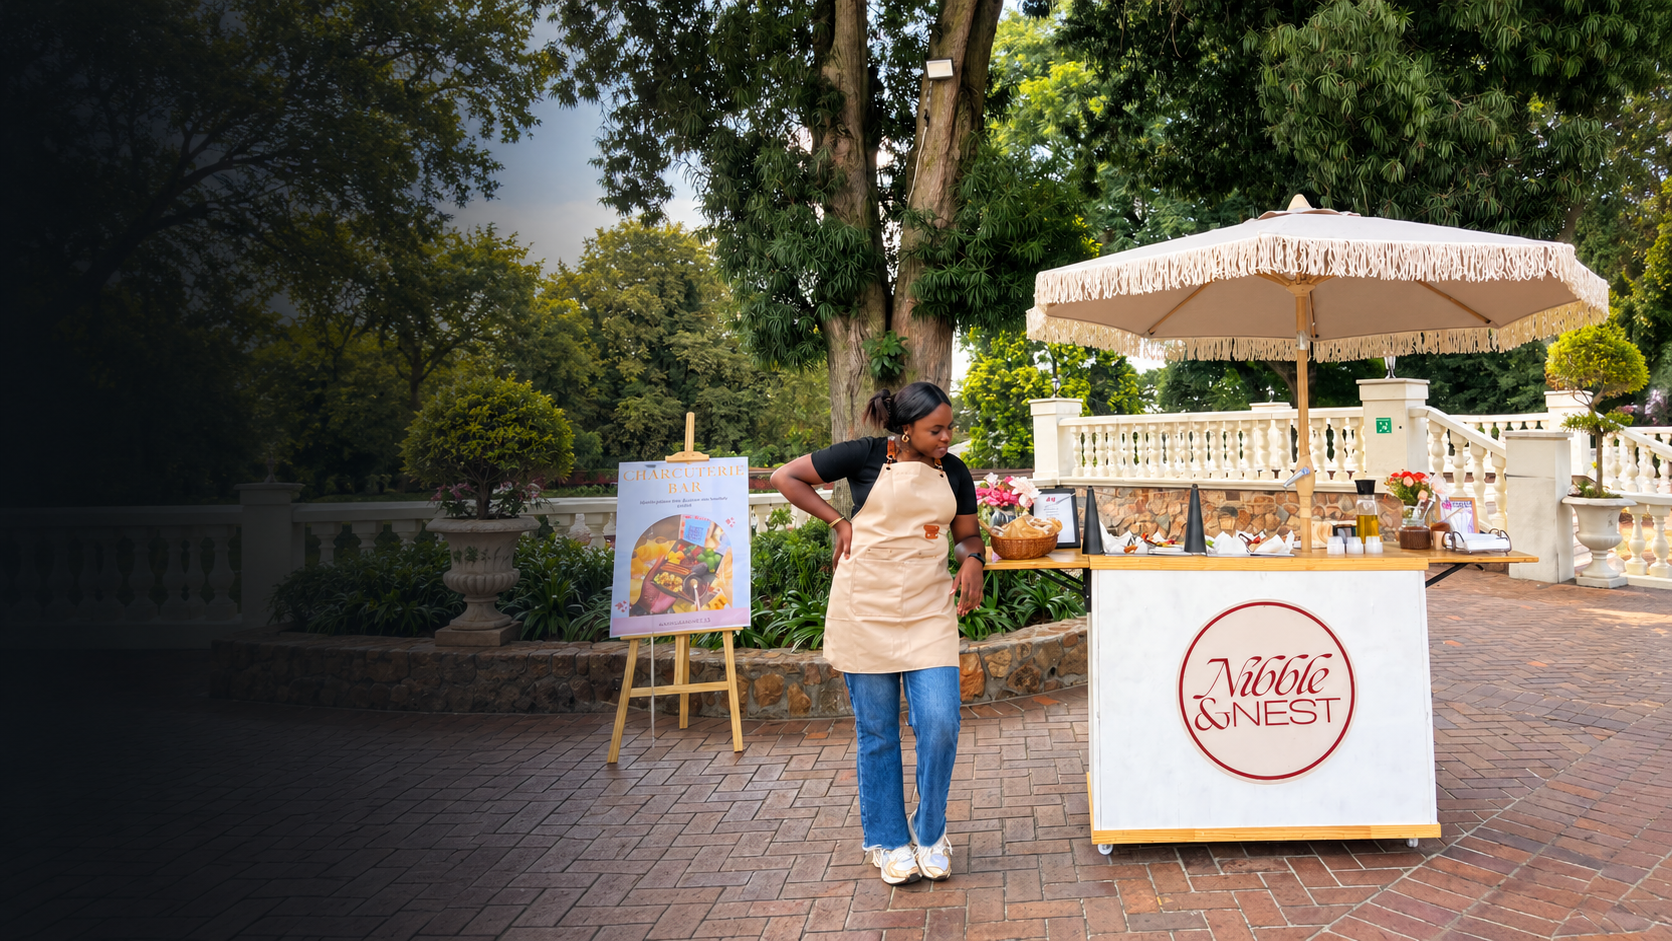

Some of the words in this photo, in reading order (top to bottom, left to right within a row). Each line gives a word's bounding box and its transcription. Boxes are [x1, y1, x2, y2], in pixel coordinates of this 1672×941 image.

[623, 465, 744, 482] CHARCUTERIE
[668, 482, 702, 494] BAR
[1192, 653, 1333, 699] Nibble
